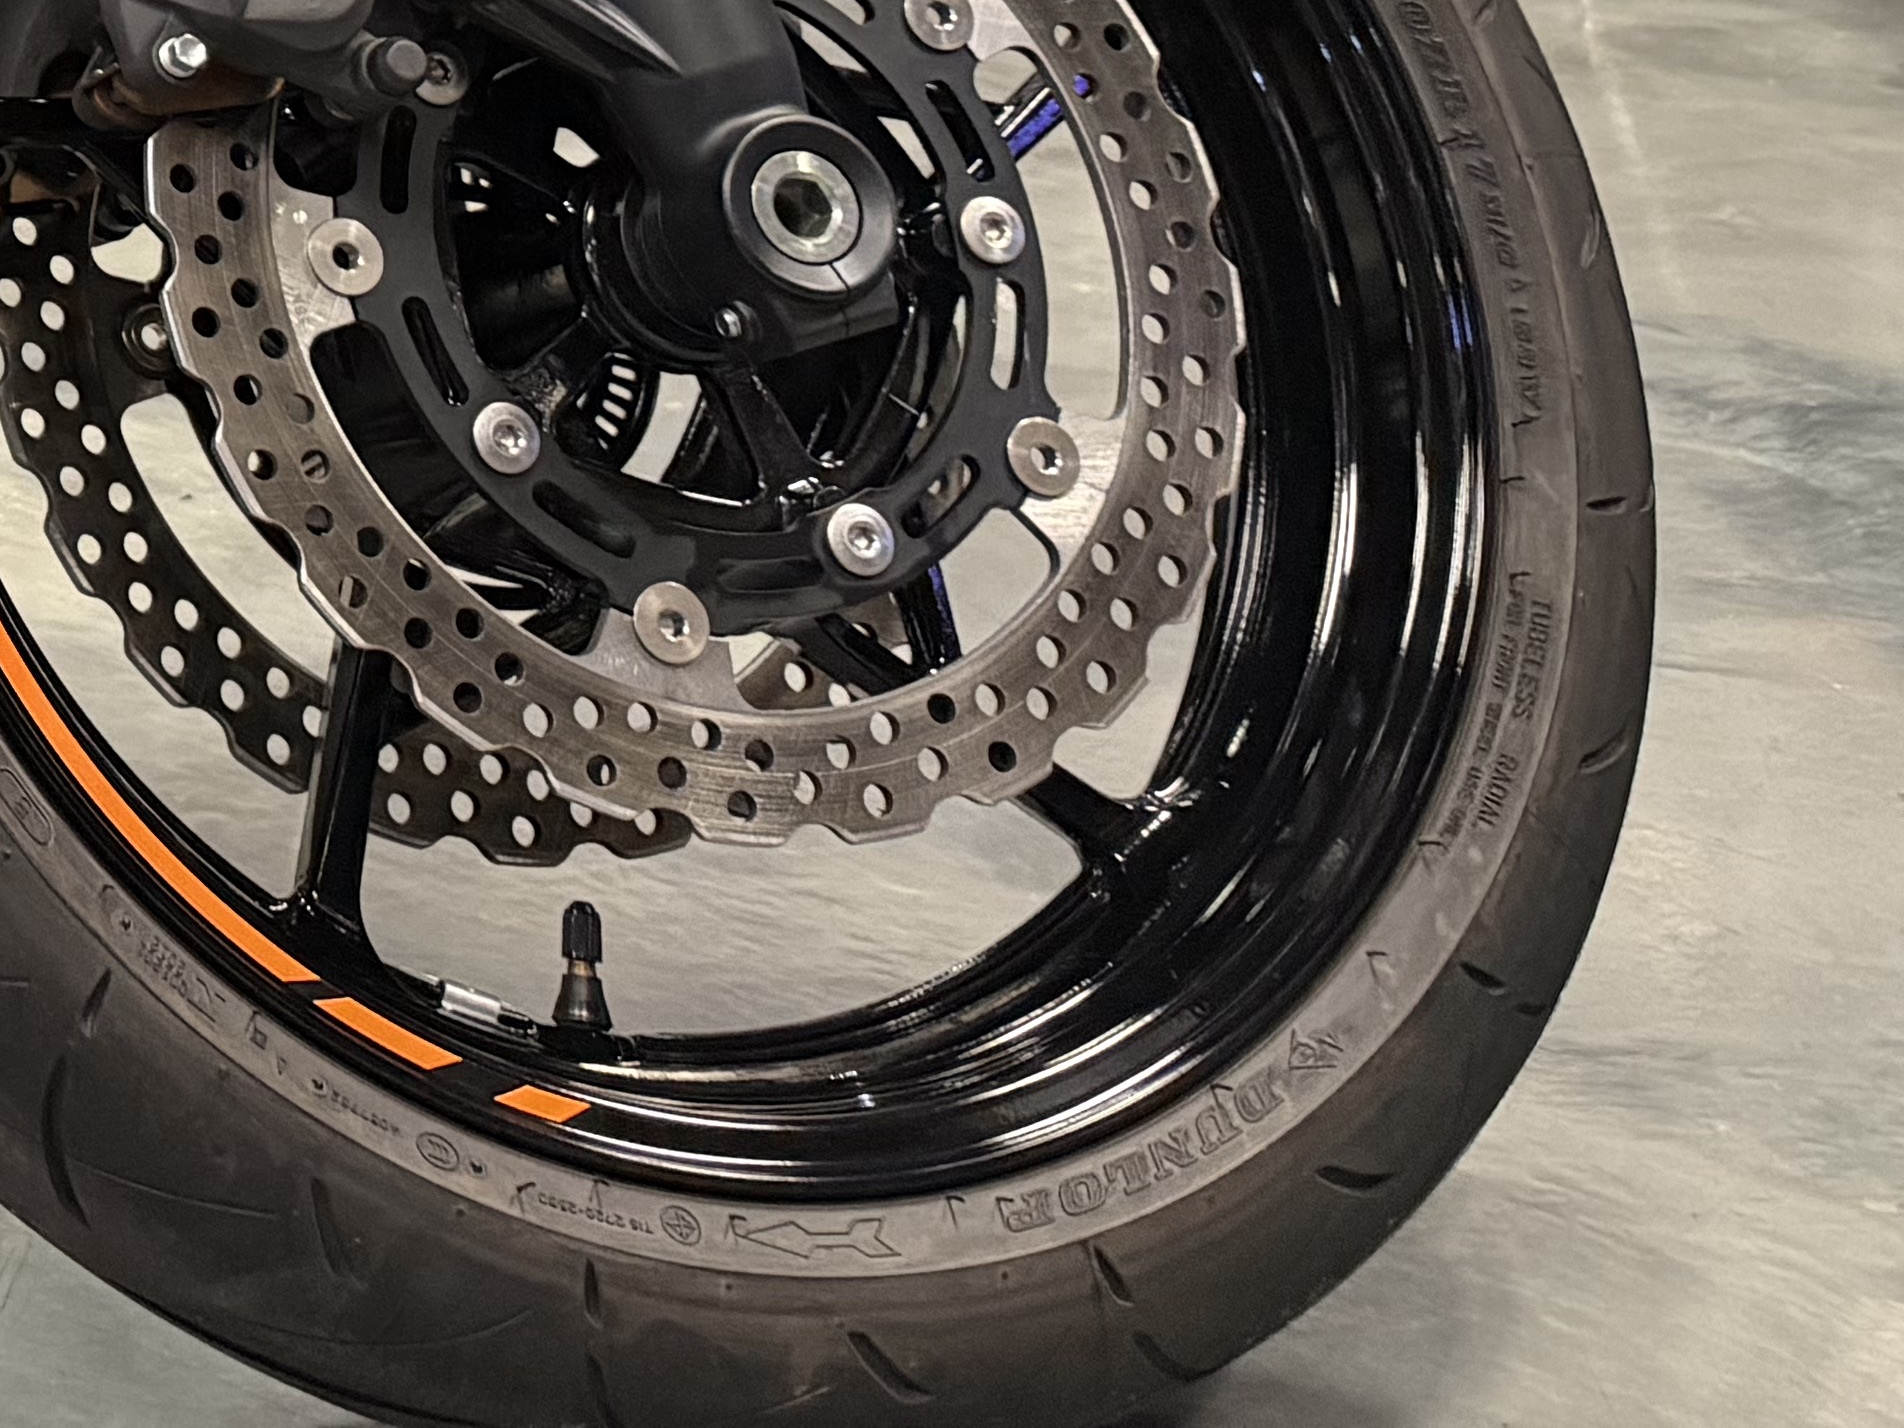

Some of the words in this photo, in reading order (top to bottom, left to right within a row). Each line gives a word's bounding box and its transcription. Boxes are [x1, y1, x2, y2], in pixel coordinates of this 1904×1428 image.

[1511, 599, 1553, 722] TUBELESS
[1477, 753, 1521, 830] RADIAL
[1002, 1061, 1287, 1233] DUNLOP
